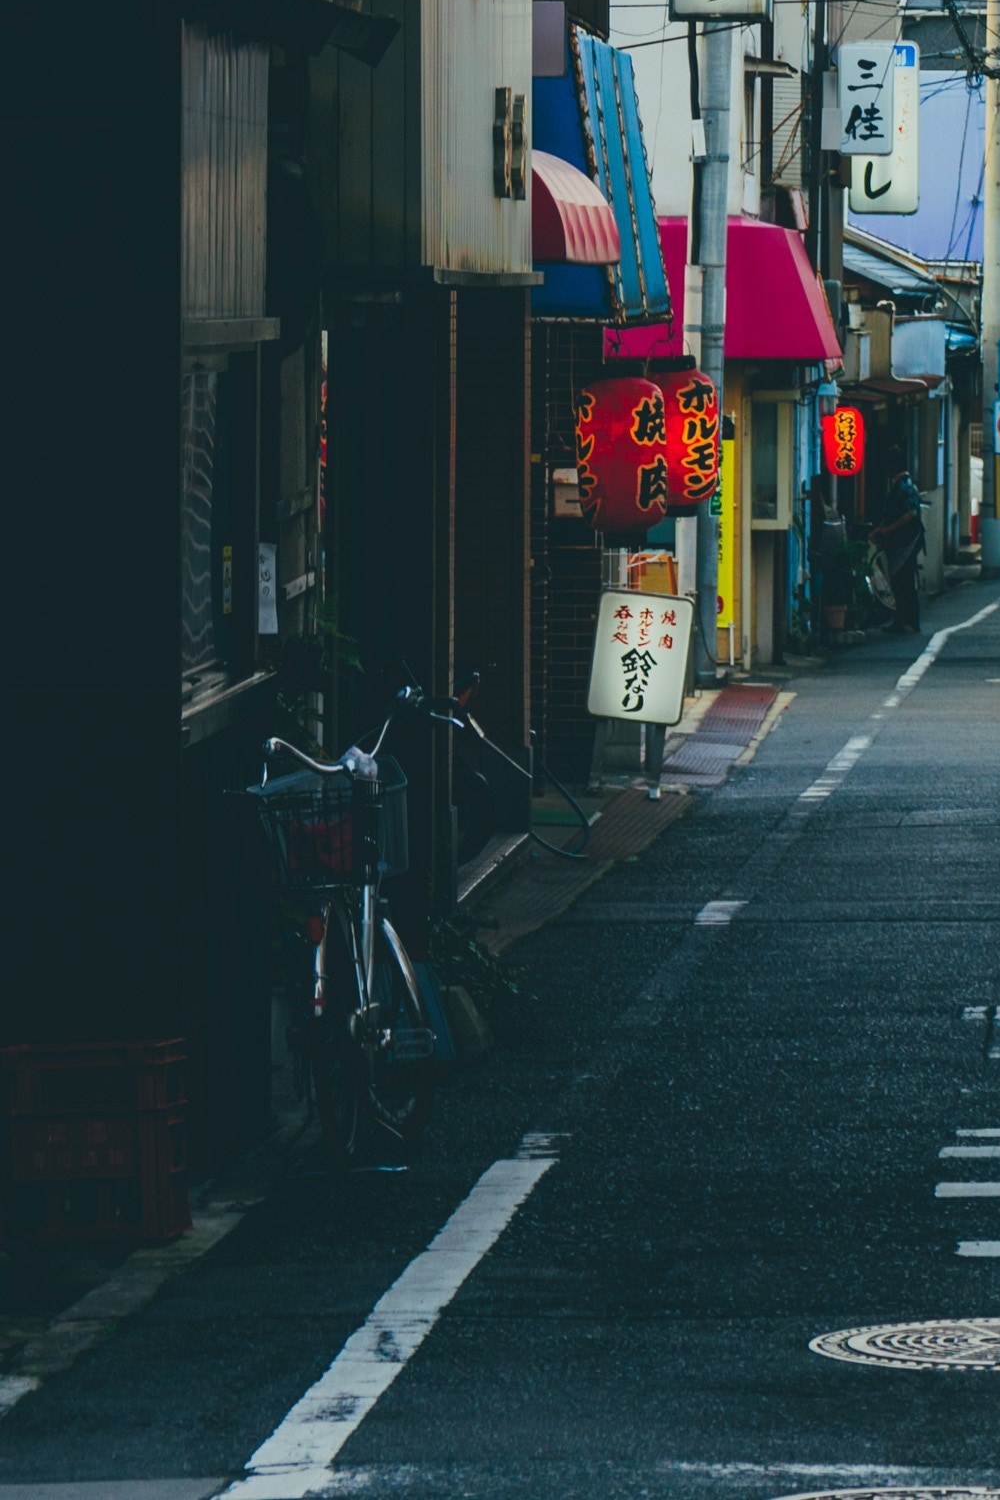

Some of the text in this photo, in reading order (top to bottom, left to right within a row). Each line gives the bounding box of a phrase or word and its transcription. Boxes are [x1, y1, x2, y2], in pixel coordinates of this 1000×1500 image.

[632, 393, 668, 513] 焼肉
[678, 378, 719, 498] ホルモン
[637, 607, 656, 648] ホルモン
[657, 609, 678, 651] 焼肉
[620, 647, 658, 713] 鈴なり
